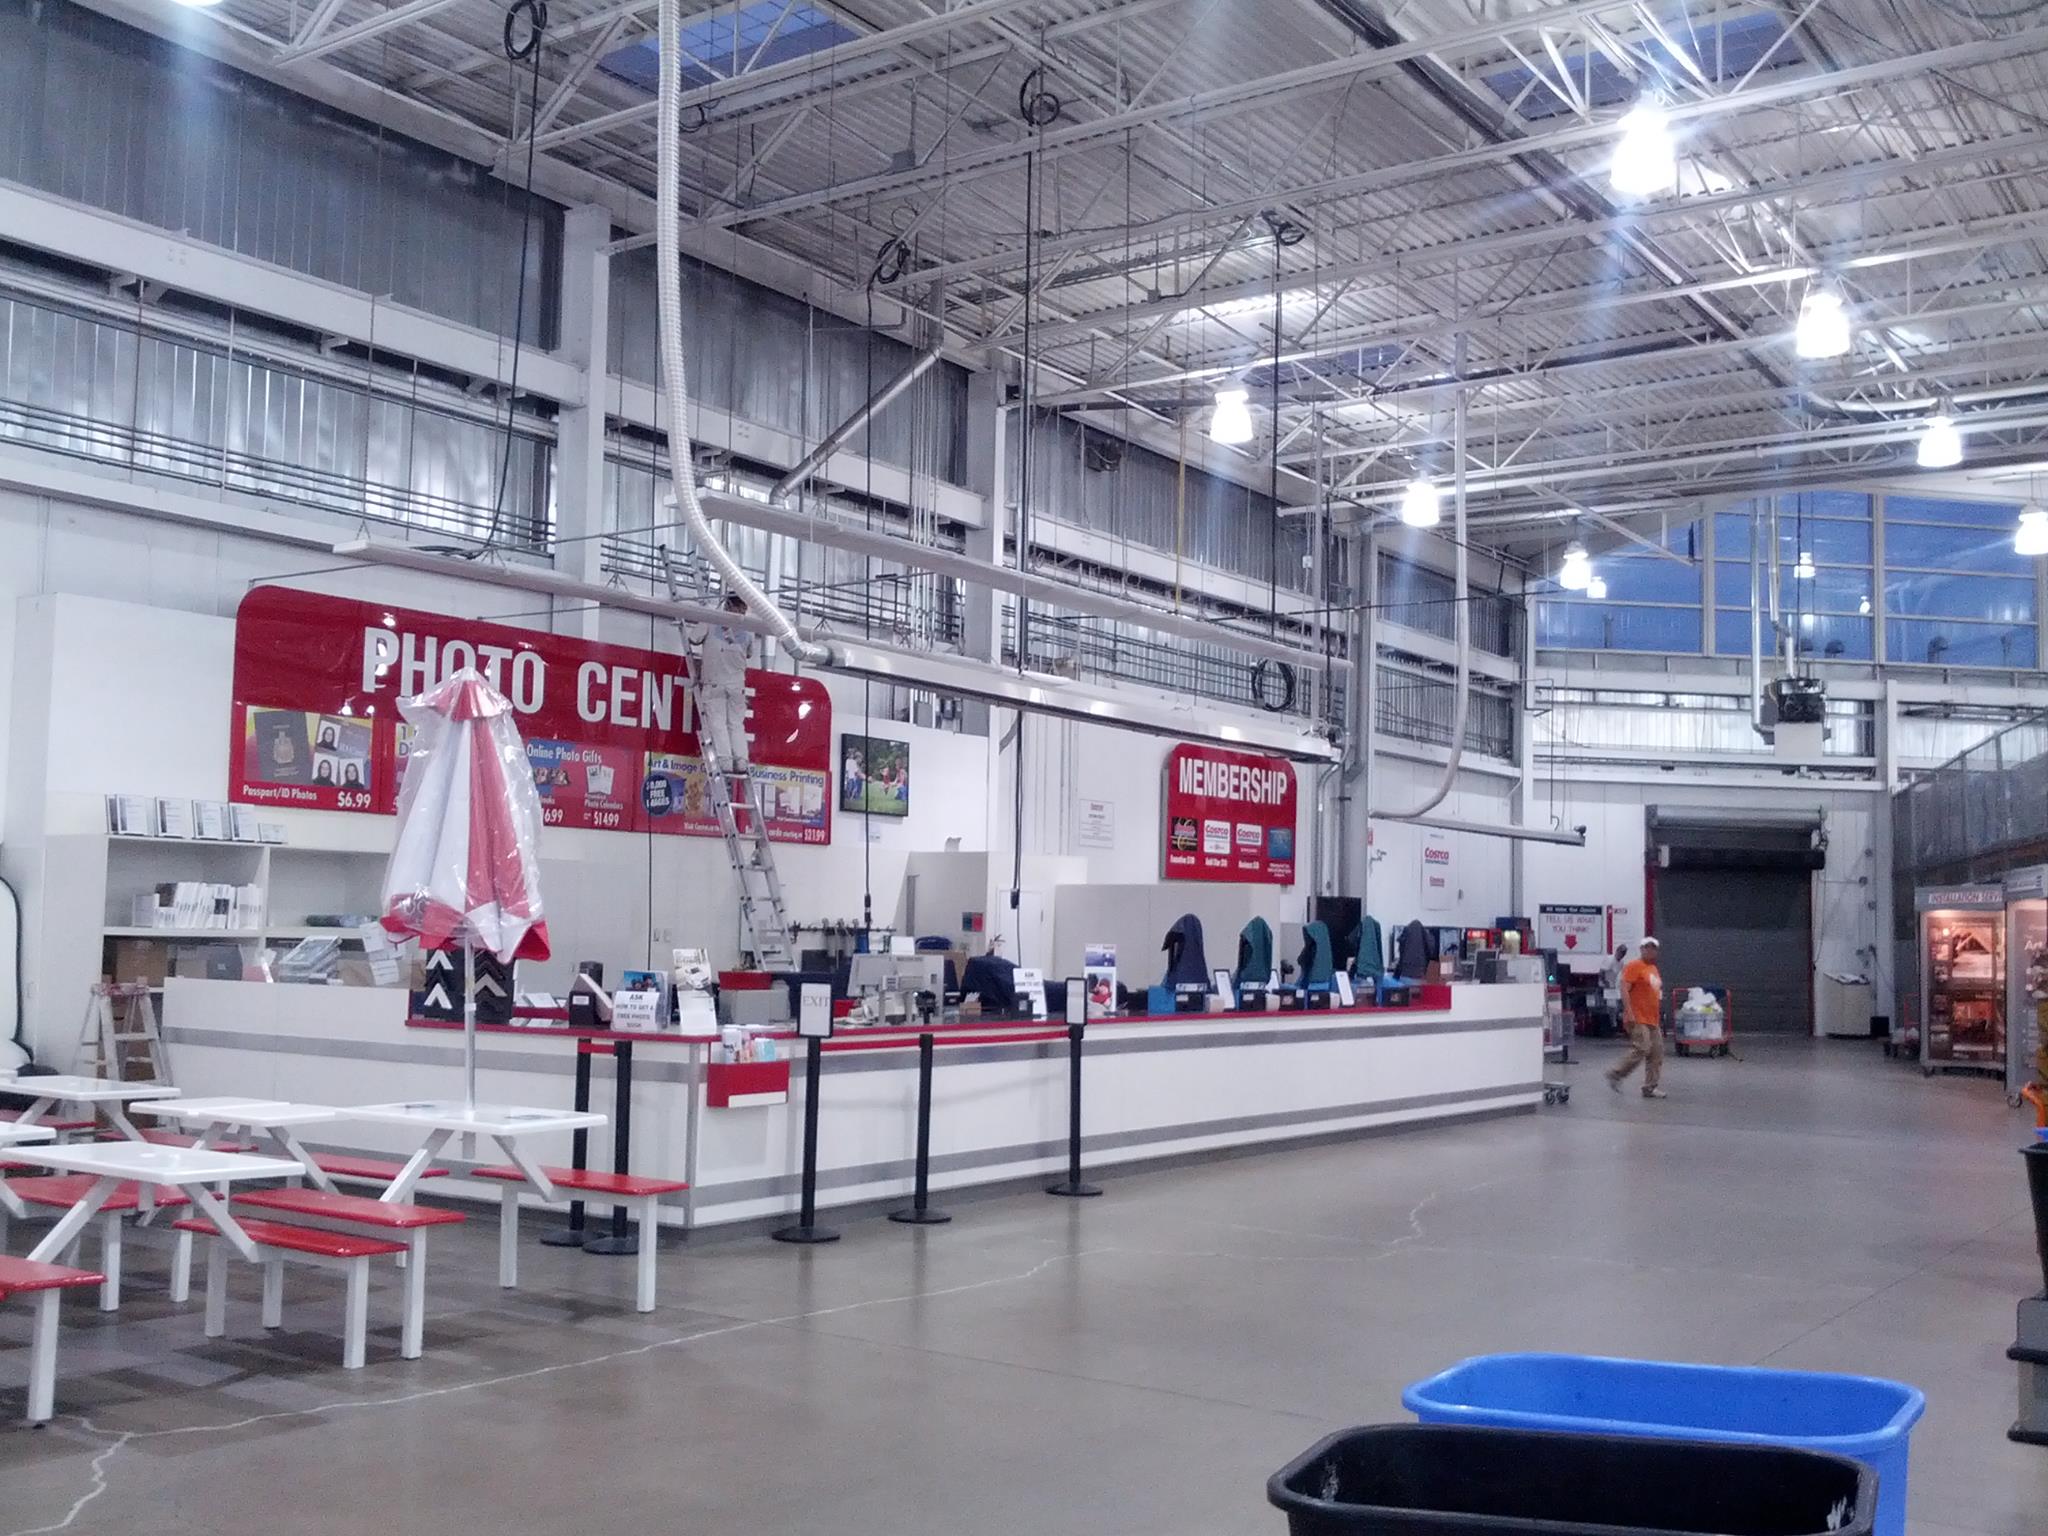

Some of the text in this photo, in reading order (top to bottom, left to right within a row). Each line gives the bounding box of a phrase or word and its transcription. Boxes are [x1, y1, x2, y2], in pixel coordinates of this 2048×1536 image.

[362, 626, 756, 742] PHOTO CENTE
[526, 743, 602, 764] Online Photo Gifts
[648, 757, 661, 768] Art
[663, 759, 669, 769] &
[671, 760, 697, 774] Image
[749, 767, 824, 788] Business Printing
[1179, 756, 1288, 806] MEMBERSHIP
[242, 784, 317, 801] Passport/ID Photos
[336, 791, 371, 809] $6.99
[650, 790, 665, 801] FREE
[593, 811, 619, 827] $14.99
[1545, 914, 1596, 925] TELL US WHAT
[1552, 925, 1566, 933] YOU
[629, 993, 643, 1001] ASK
[803, 996, 829, 1008] EXIT
